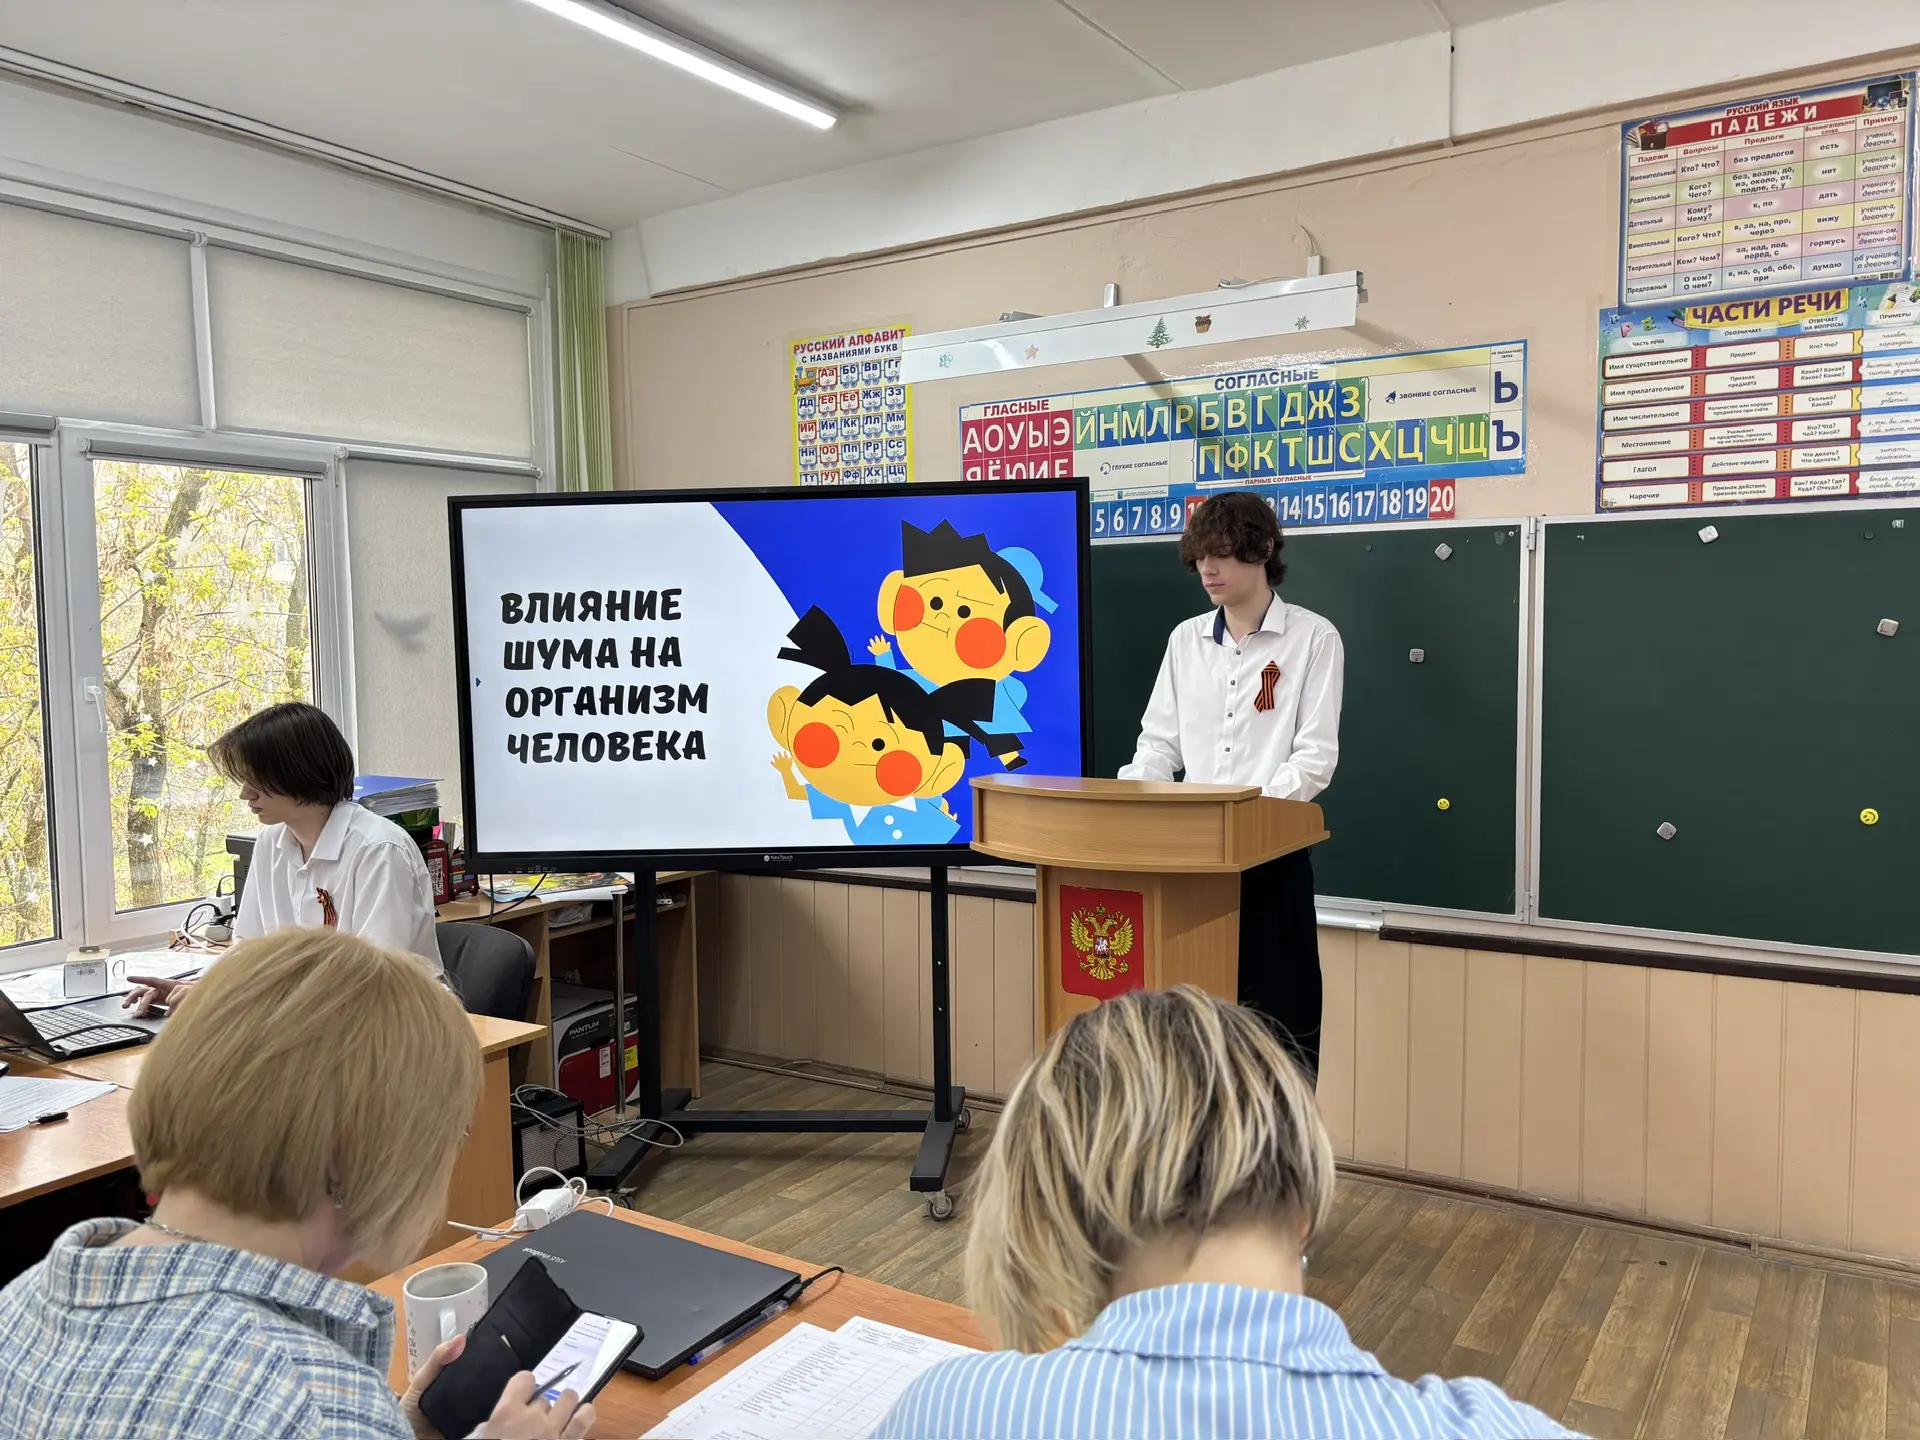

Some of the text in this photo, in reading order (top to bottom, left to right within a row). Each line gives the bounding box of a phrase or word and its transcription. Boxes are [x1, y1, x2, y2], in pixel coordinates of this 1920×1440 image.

[1726, 97, 1799, 116] РУССКИЙ ЯЗЫК
[1710, 105, 1817, 136] ПАДЕЖИ
[1863, 115, 1898, 126] Пример
[1744, 133, 1784, 146] Предлоги
[1683, 145, 1718, 155] Вопросы
[1638, 153, 1668, 163] Падежи
[1750, 150, 1794, 163] предлогов
[1681, 161, 1719, 173] Кто? Что?
[1630, 170, 1676, 181] Именительный
[1689, 182, 1711, 191] Кого?
[1629, 192, 1670, 204] Родительный
[1688, 190, 1711, 198] Чего?
[1819, 192, 1838, 200] дать
[1687, 205, 1712, 214] Кому?
[1629, 217, 1663, 228] Дательный
[1687, 214, 1712, 222] Чему?
[1817, 215, 1839, 223] вижу
[1677, 231, 1721, 243] Кого? Что?
[1810, 238, 1845, 247] горжусь
[1628, 239, 1670, 249] Винительный
[1677, 253, 1720, 265] Кем? Чем?
[1628, 261, 1672, 272] Творительный
[1812, 262, 1841, 271] думаю
[1627, 283, 1667, 294] Предложный
[1692, 281, 1712, 289] чем?
[1692, 290, 1841, 324] ЧАСТИ РЕЧИ
[793, 329, 906, 355] РУССКИЙ АЛФАВИТ
[810, 347, 871, 362] НАЗВАНИЯМИ
[874, 343, 898, 354] БУКВ
[1625, 357, 1688, 369] существительное
[1214, 369, 1319, 391] СОГЛАСНЫЕ
[1399, 386, 1477, 400] ЗВОНКИЕ СОГЛАСНЫЕ
[1627, 385, 1684, 396] прилагательное
[983, 399, 1050, 418] ГЛАСНЫЕ
[1629, 411, 1680, 420] числительное
[1621, 440, 1671, 448] Местоимение
[1633, 466, 1657, 474] Глагол
[1273, 475, 1312, 483] СОГЛАСНЫЕ
[1095, 509, 1105, 532] 5
[1113, 507, 1124, 531] 6
[1132, 506, 1142, 530] 7
[1150, 505, 1161, 529] 8
[1170, 503, 1181, 528] 9
[1280, 495, 1301, 520] 14
[1305, 493, 1324, 519] 15
[1329, 491, 1350, 518] 16
[1354, 490, 1376, 516] 17
[1380, 488, 1401, 515] 18
[1405, 487, 1427, 513] 19
[1430, 485, 1454, 512] 20
[501, 588, 682, 624] ВЛИЯНИЕ
[503, 636, 682, 670] ШУМА НА
[505, 682, 708, 718] ОРГАНИЗМ
[507, 730, 706, 764] ЧЕЛОВЕКА
[569, 1020, 600, 1036] PANTUM
